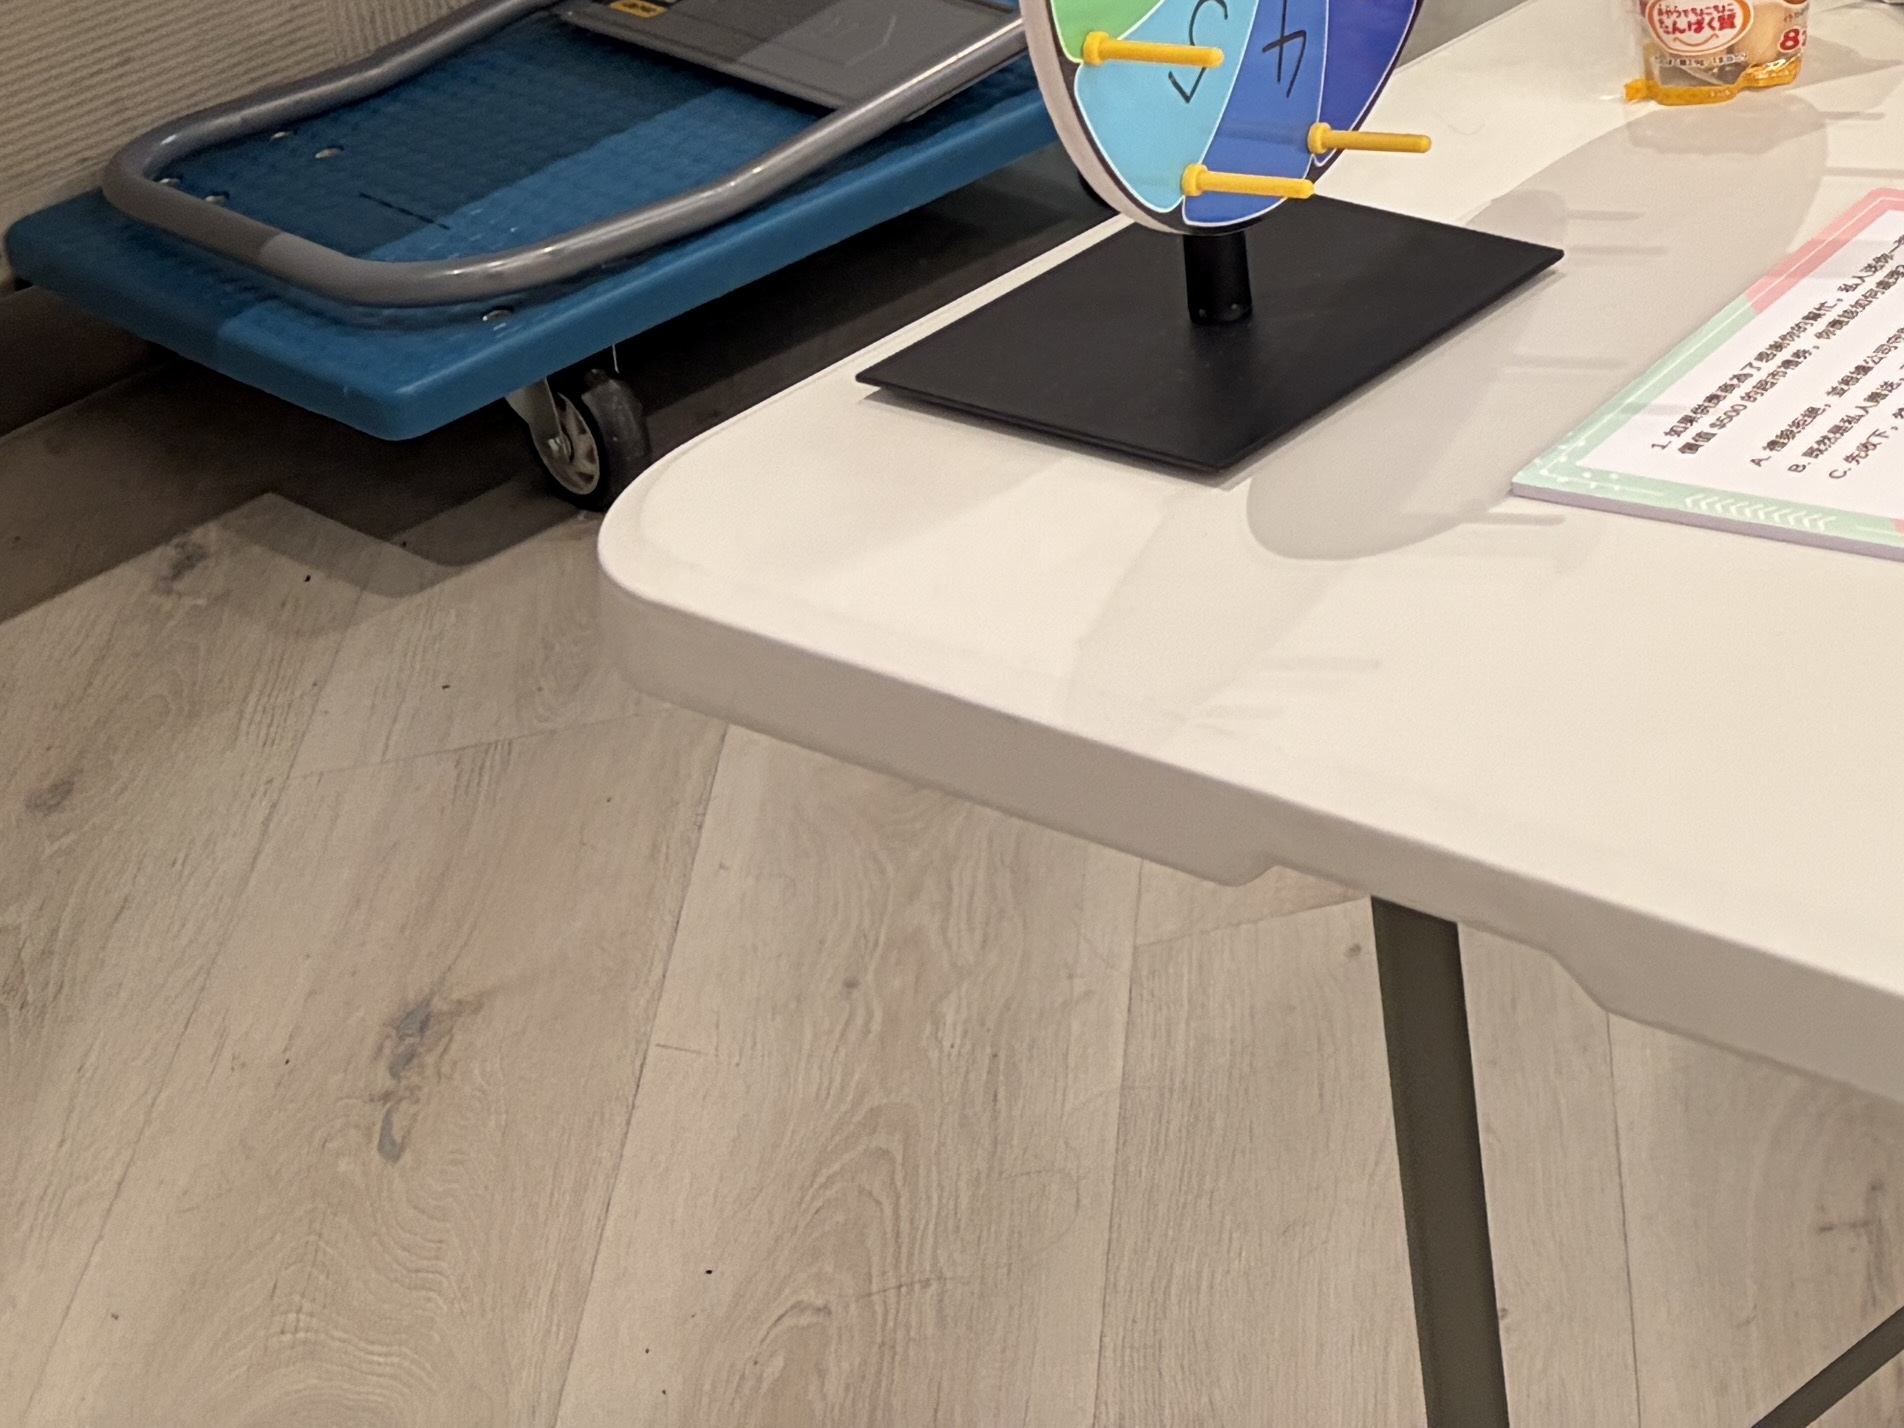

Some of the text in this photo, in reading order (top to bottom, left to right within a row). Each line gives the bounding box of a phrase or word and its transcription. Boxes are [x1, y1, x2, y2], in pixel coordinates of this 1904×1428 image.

[1709, 403, 1748, 430] $500
[1787, 462, 1811, 473] B.
[1828, 467, 1852, 480] C.
